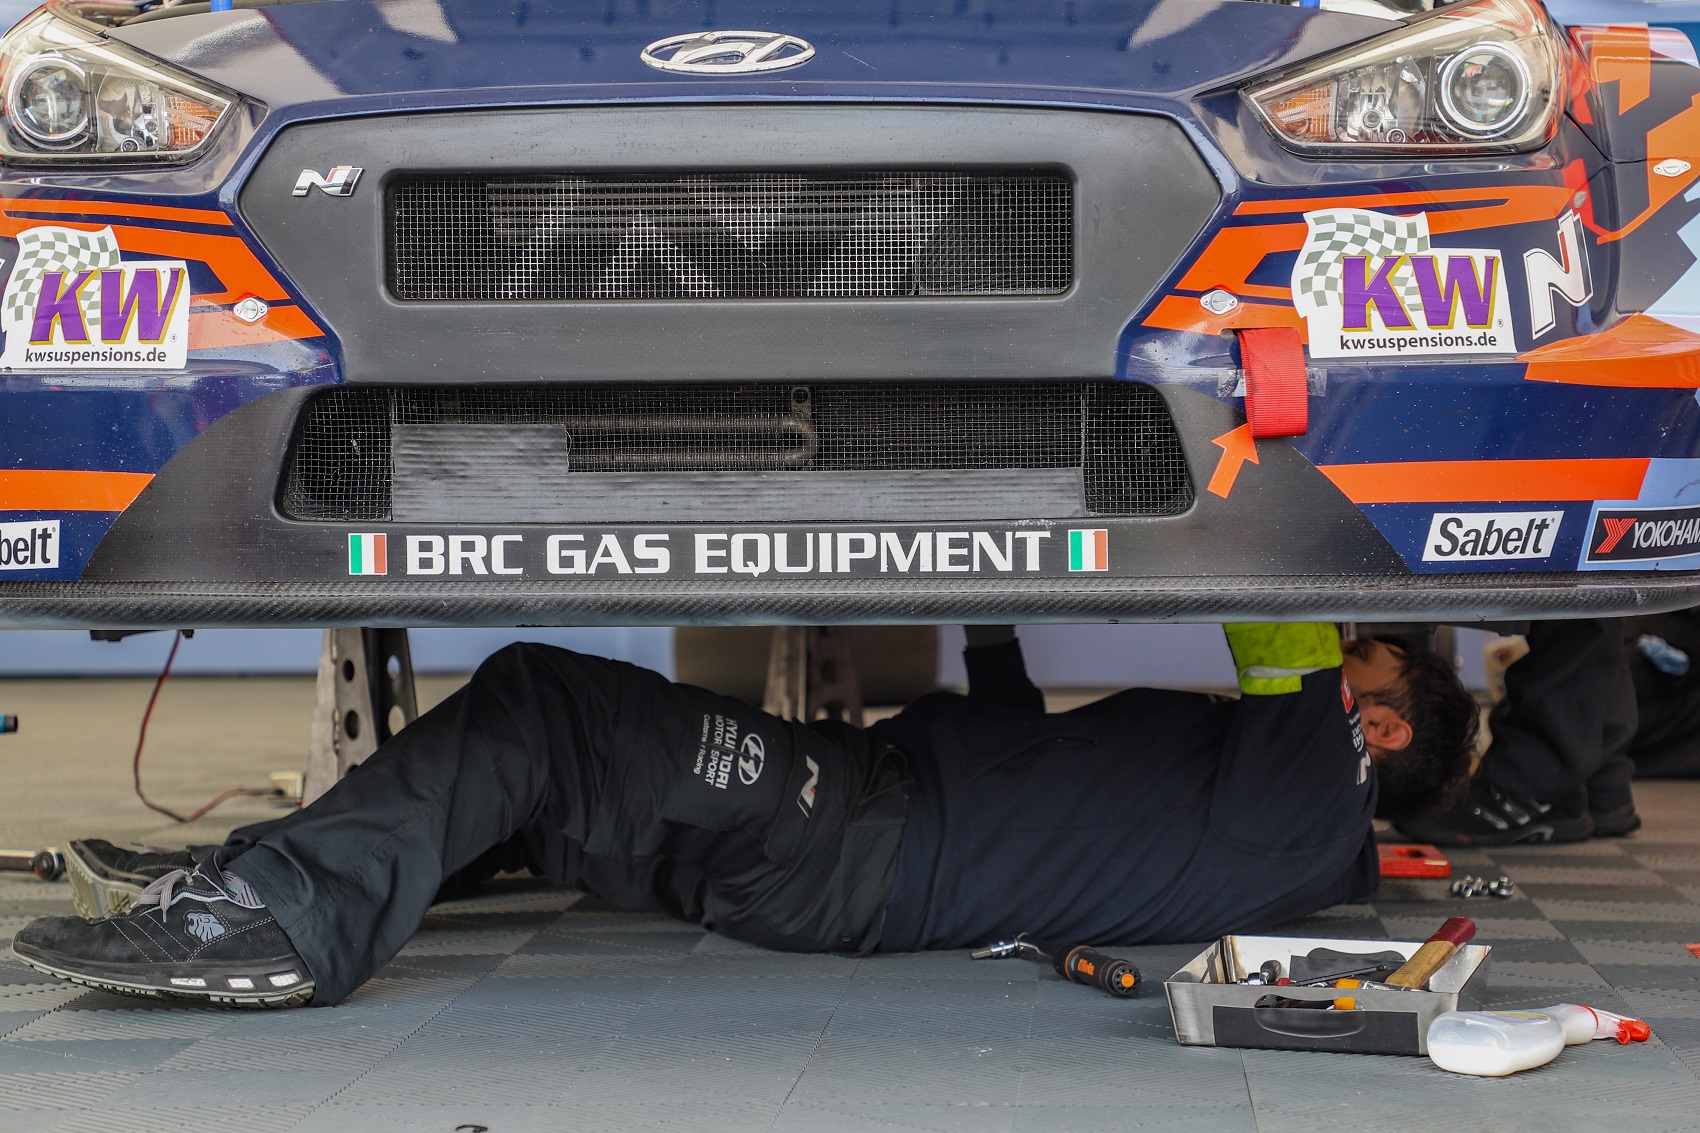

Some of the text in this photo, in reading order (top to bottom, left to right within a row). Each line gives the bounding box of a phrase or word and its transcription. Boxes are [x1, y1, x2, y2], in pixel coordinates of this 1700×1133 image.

[1341, 255, 1500, 332] KW
[1523, 208, 1594, 340] N
[28, 268, 186, 345] KW
[25, 347, 167, 365] kwsuspensions.de
[1340, 332, 1497, 351] kwsuspensions.de
[405, 531, 1052, 577] BRC GAS EQUIPMENT
[1434, 517, 1550, 557] Sabelt
[693, 748, 706, 775] Racing
